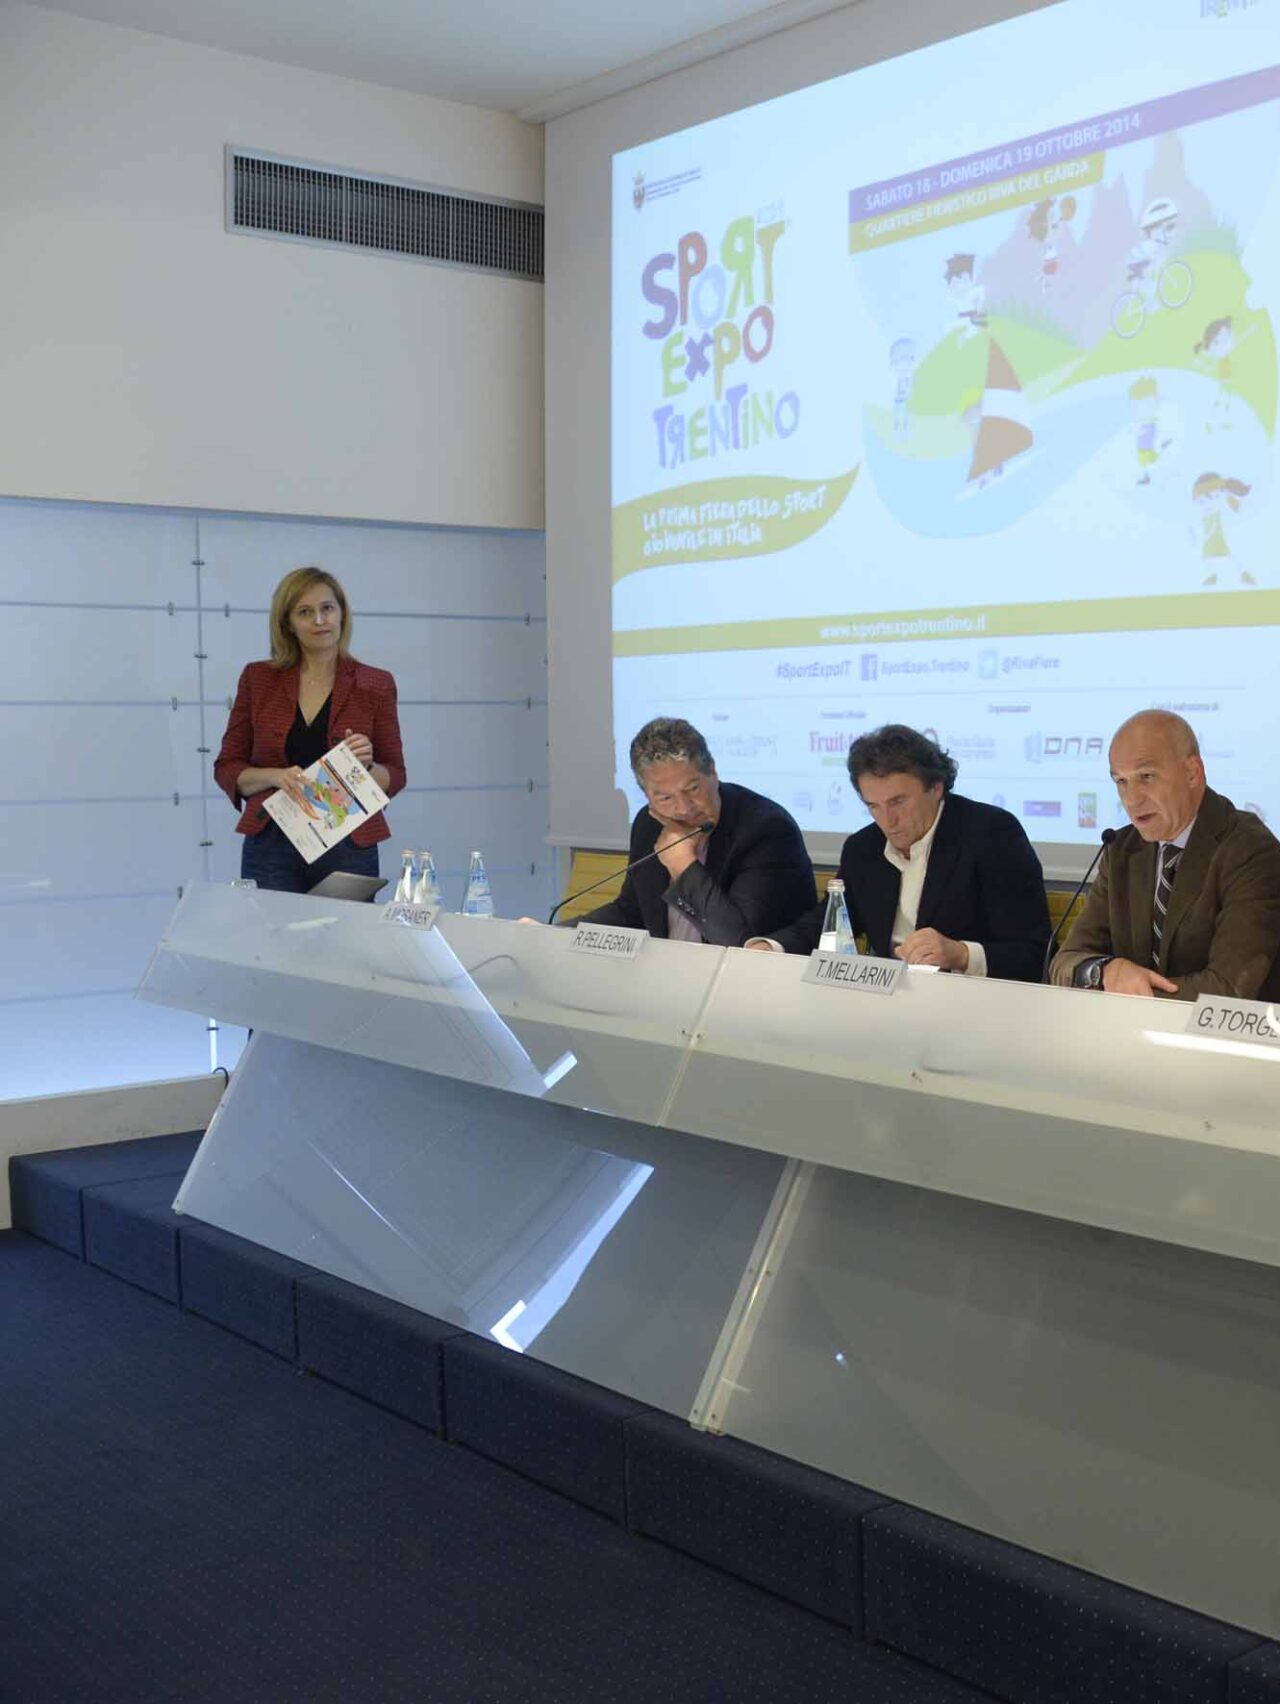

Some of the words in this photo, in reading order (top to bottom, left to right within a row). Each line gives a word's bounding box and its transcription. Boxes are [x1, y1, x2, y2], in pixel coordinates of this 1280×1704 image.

[865, 183, 914, 211] SABATO
[916, 178, 931, 197] 18
[940, 151, 1014, 188] DOMENICA
[1017, 145, 1032, 164] 19
[1034, 129, 1101, 160] OTTOBRE
[1105, 113, 1140, 138] 2014
[1018, 174, 1042, 195] DEL
[1043, 160, 1089, 184] GARDA
[642, 512, 657, 532] LA
[737, 495, 780, 519] DELLO
[815, 958, 896, 988] T.MELLARINI
